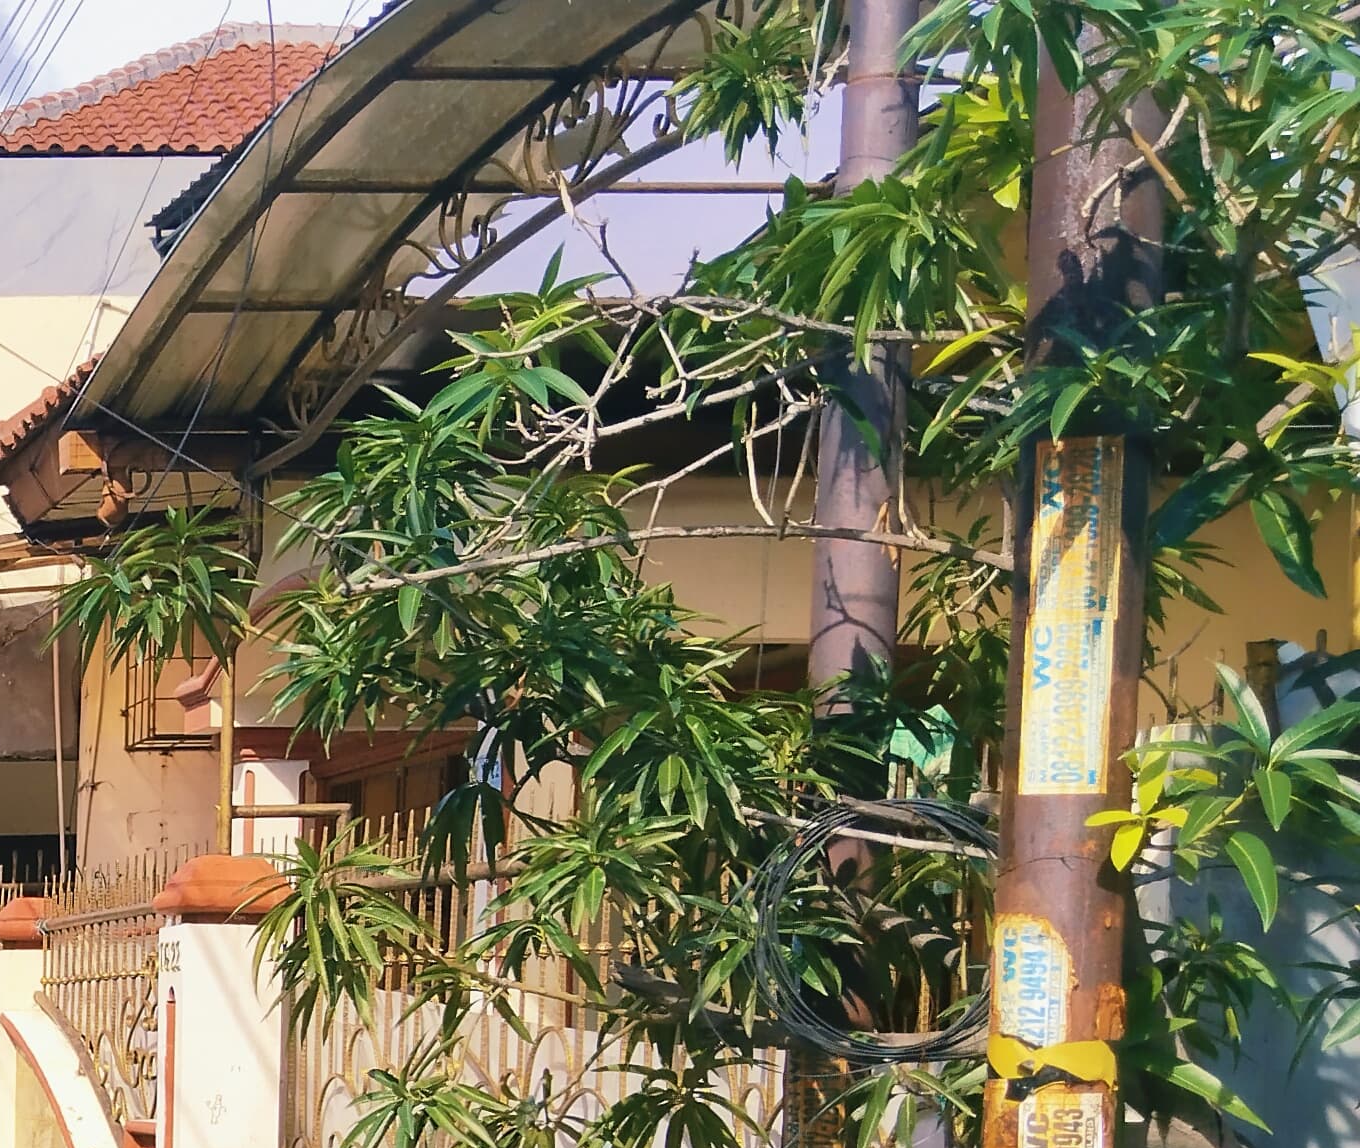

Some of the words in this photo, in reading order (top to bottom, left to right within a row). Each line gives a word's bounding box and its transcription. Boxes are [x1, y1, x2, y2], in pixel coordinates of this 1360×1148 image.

[1032, 626, 1052, 690] WC
[1018, 951, 1048, 1000] 9494
[1018, 1007, 1045, 1043] 212
